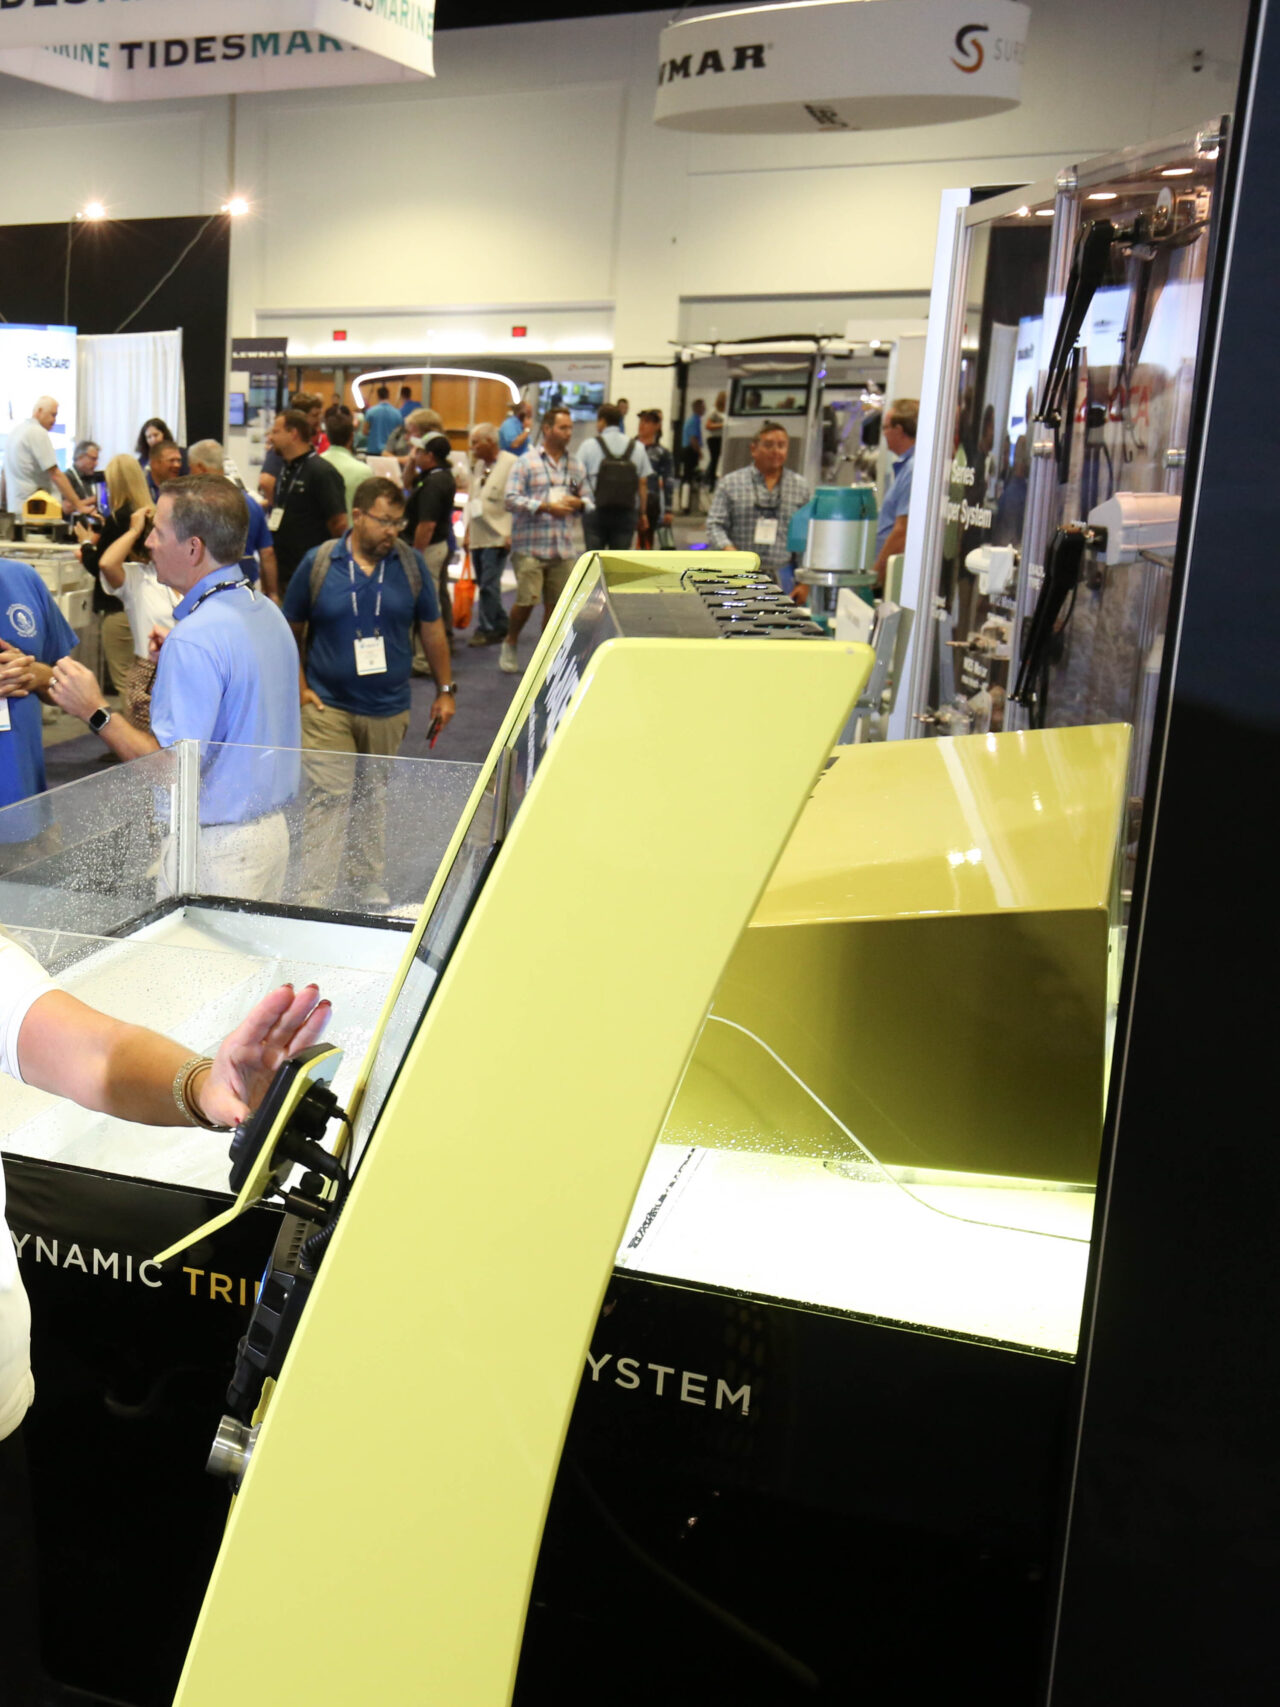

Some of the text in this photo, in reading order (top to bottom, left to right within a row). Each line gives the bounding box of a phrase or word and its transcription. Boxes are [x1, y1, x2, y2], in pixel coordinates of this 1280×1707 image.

[960, 498, 993, 531] System
[10, 1230, 163, 1288] YNAMIC
[586, 1350, 751, 1416] YSTEM
